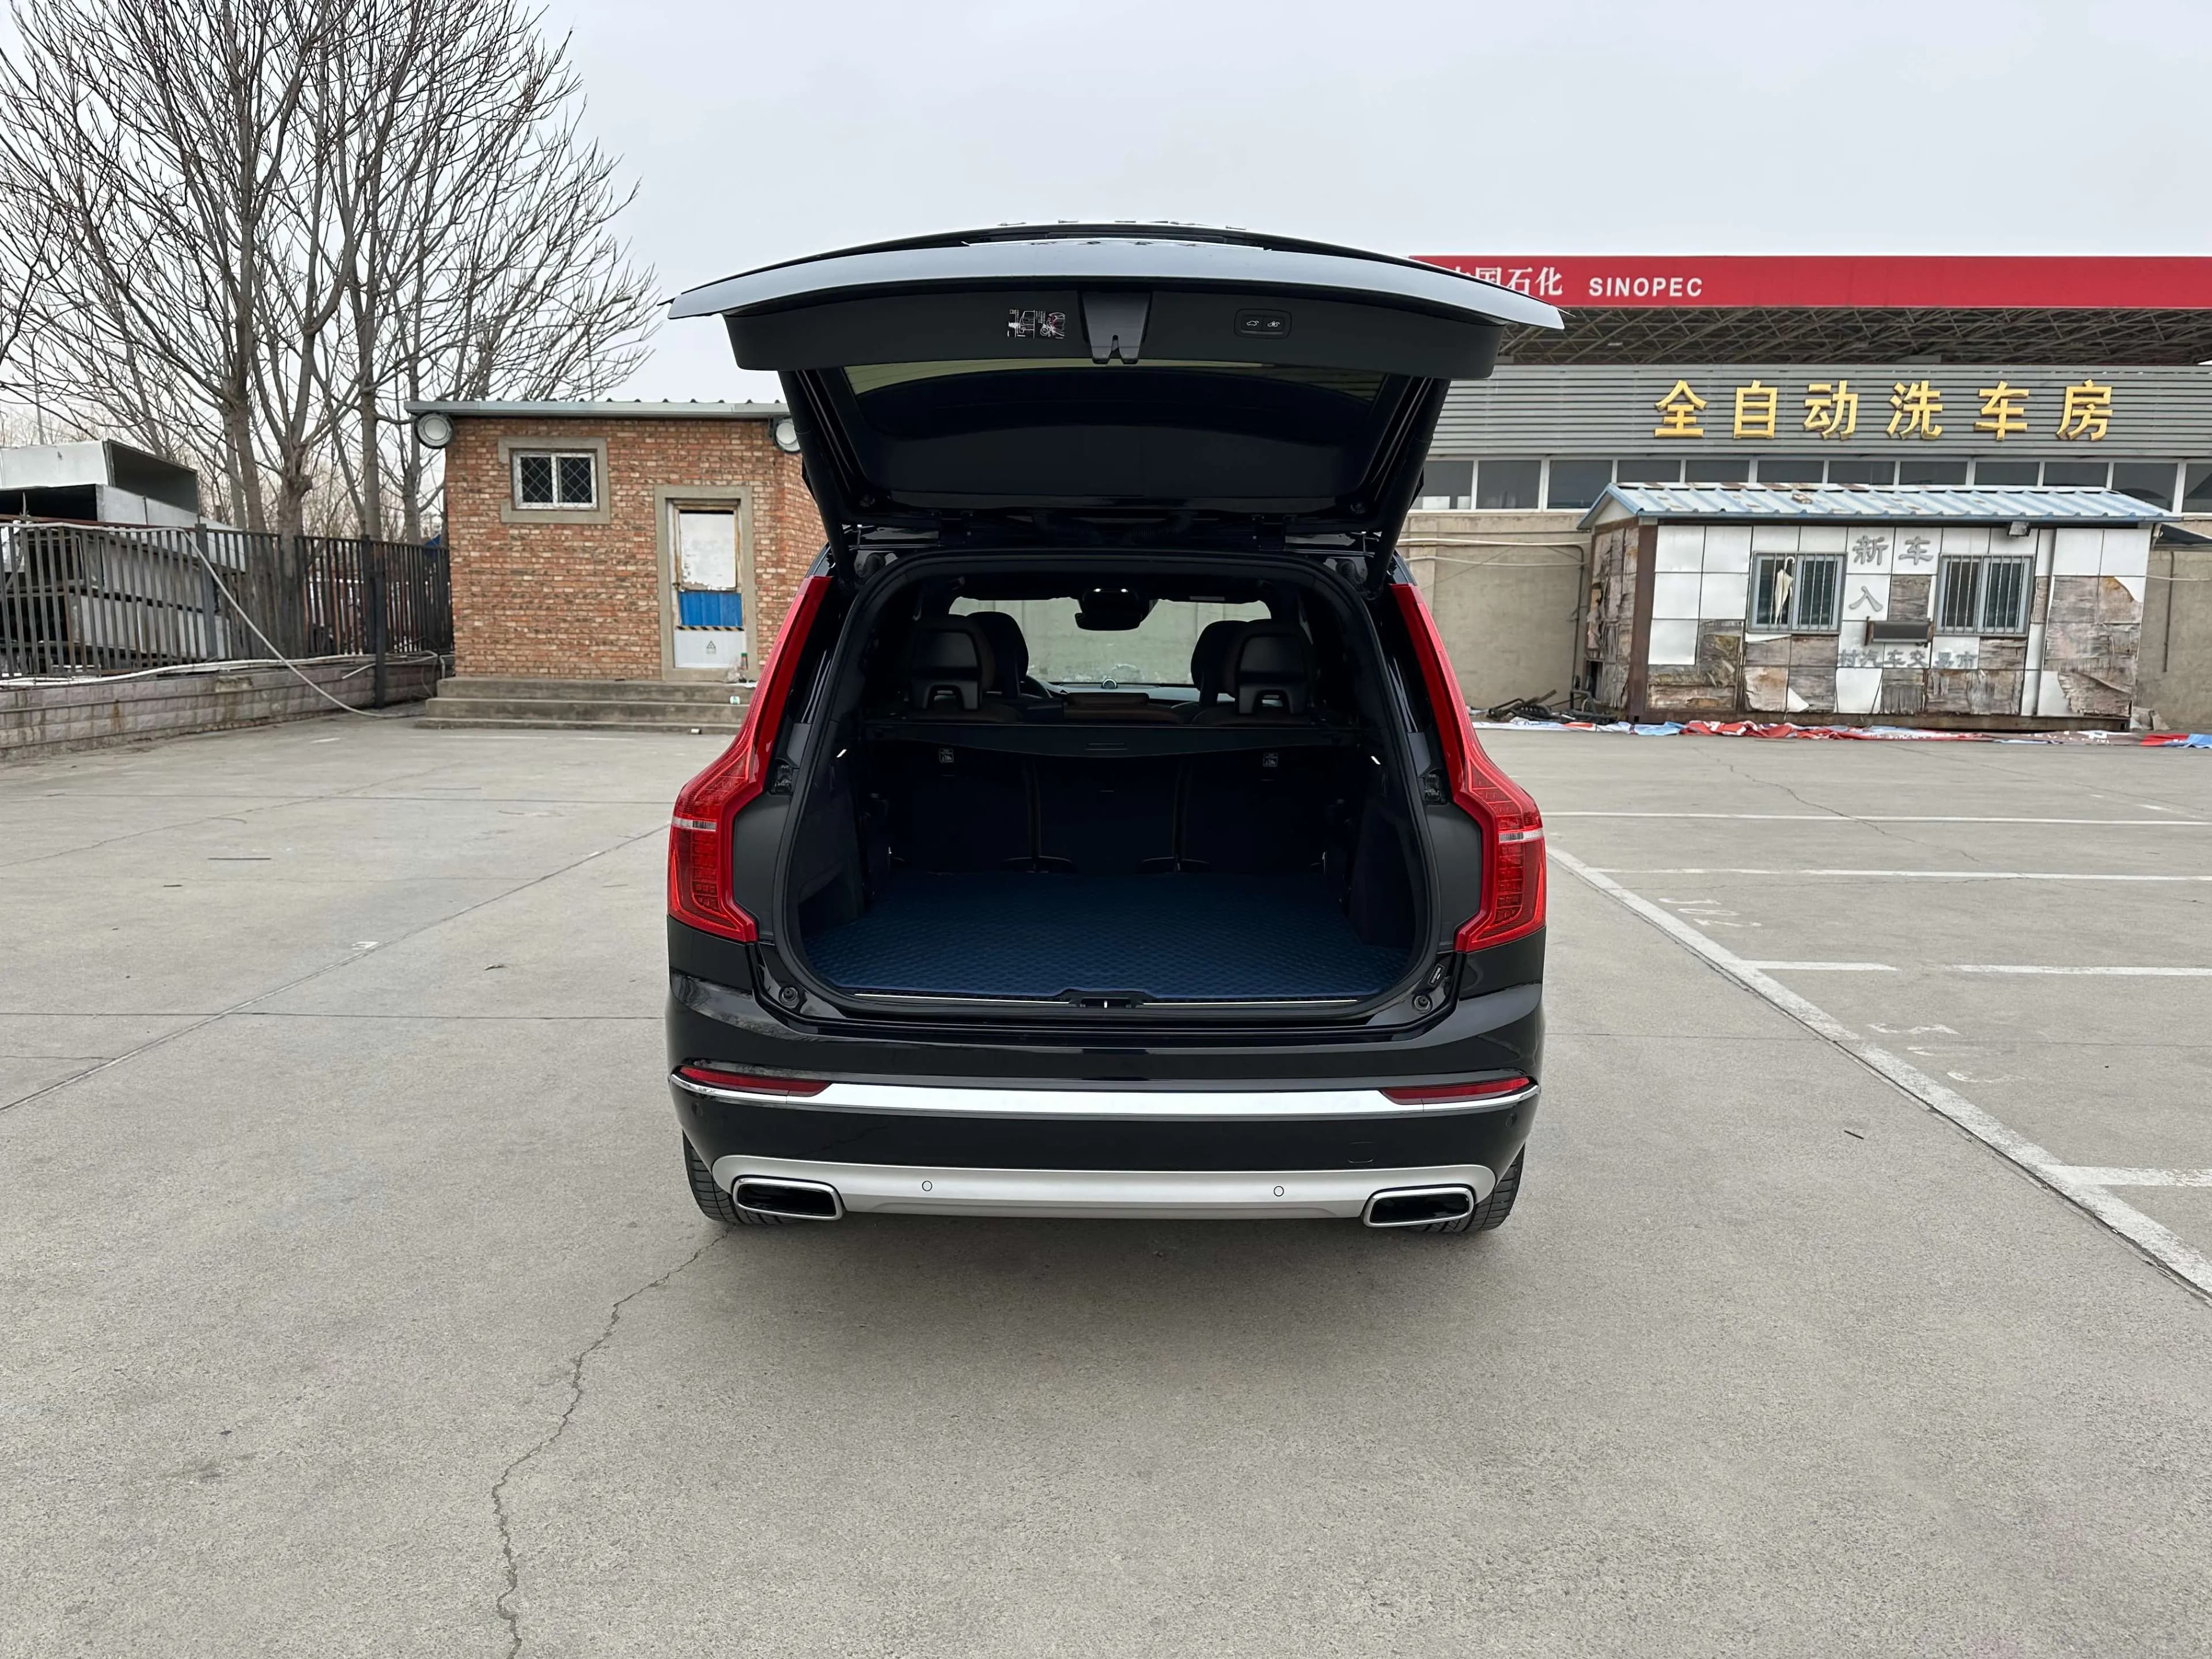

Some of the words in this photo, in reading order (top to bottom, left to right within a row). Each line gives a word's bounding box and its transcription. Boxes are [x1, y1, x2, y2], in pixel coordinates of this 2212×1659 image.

[1589, 277, 1702, 297] SINOPEC
[1654, 379, 2113, 441] 全自动洗车房
[1852, 535, 1934, 566] 新车
[1848, 585, 1884, 612] 入
